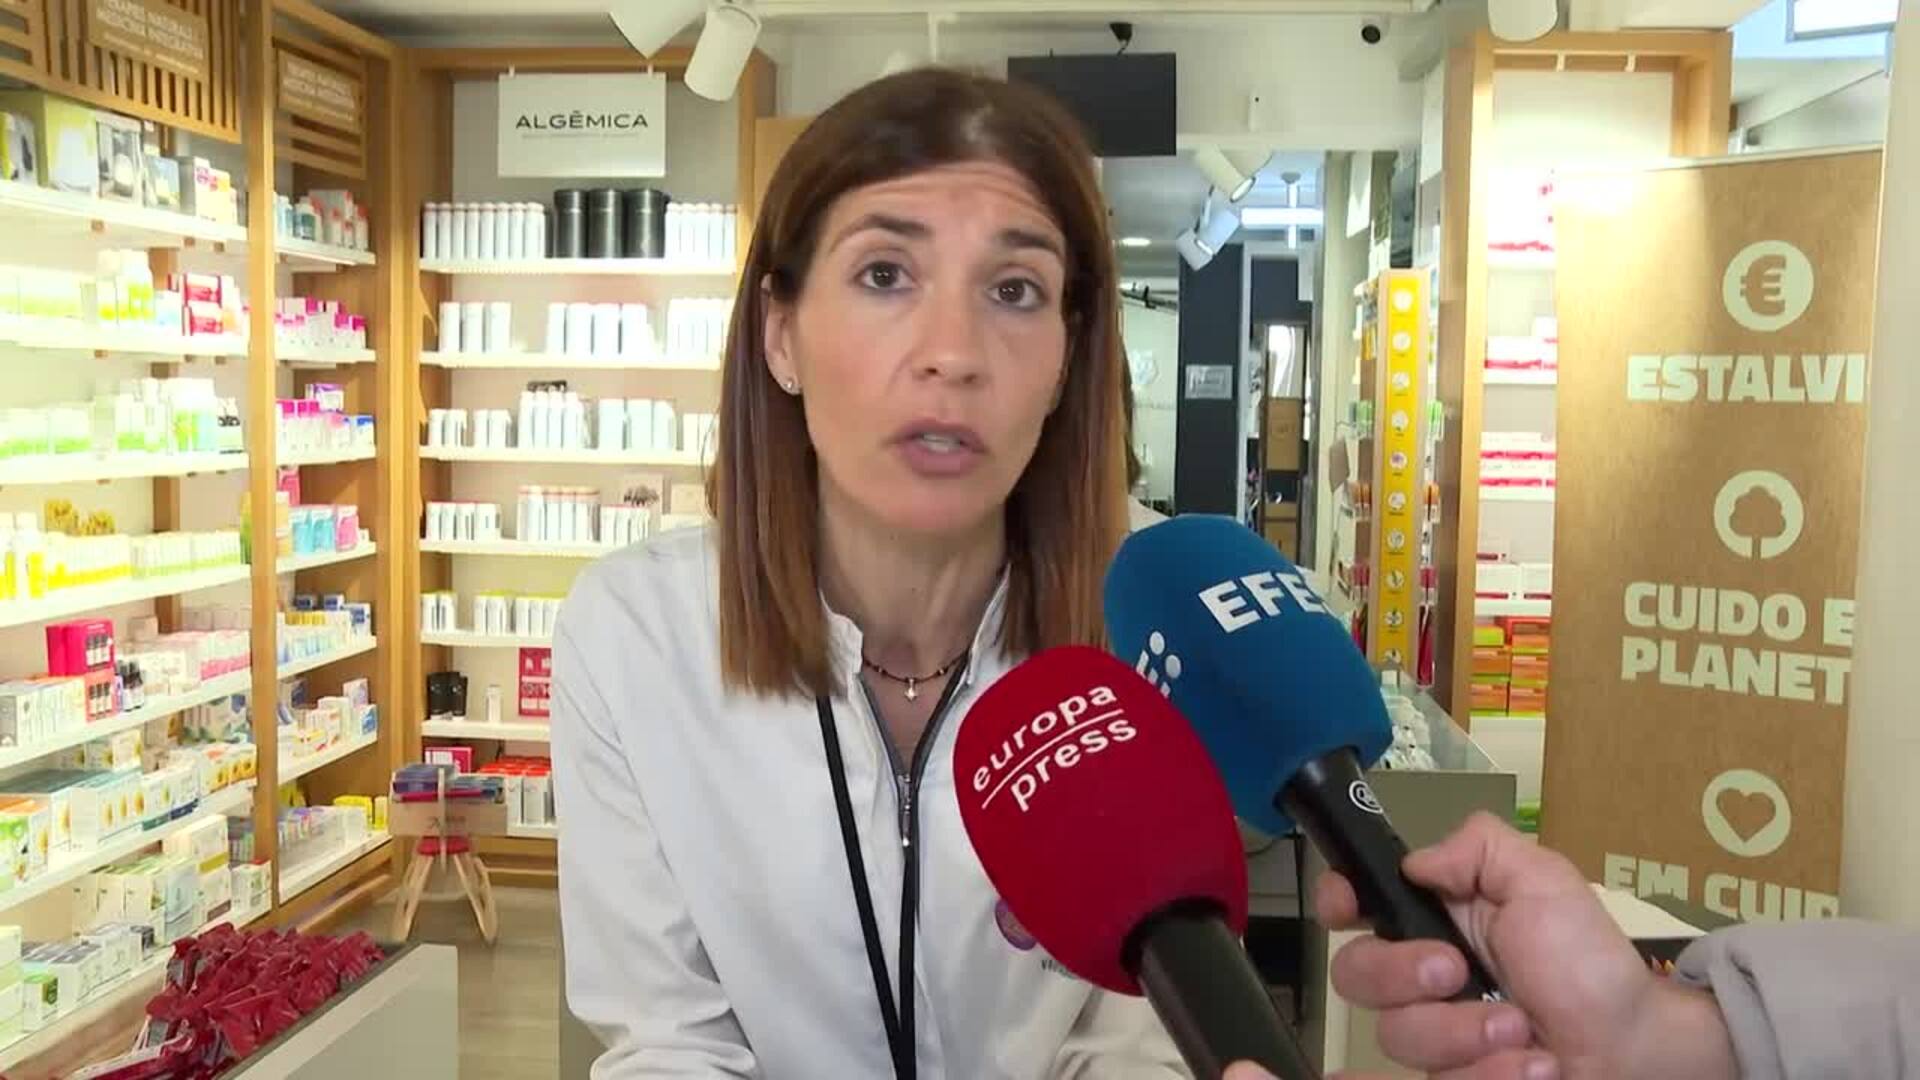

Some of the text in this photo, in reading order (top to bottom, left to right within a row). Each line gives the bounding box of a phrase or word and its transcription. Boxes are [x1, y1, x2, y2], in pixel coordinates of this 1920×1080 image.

[1626, 353, 1867, 404] ESTALVI
[1624, 582, 1807, 642] CUIDO
[1621, 635, 1852, 705] PLANET
[973, 685, 1118, 792] europa
[1010, 719, 1137, 812] press
[1604, 852, 1689, 901] EM
